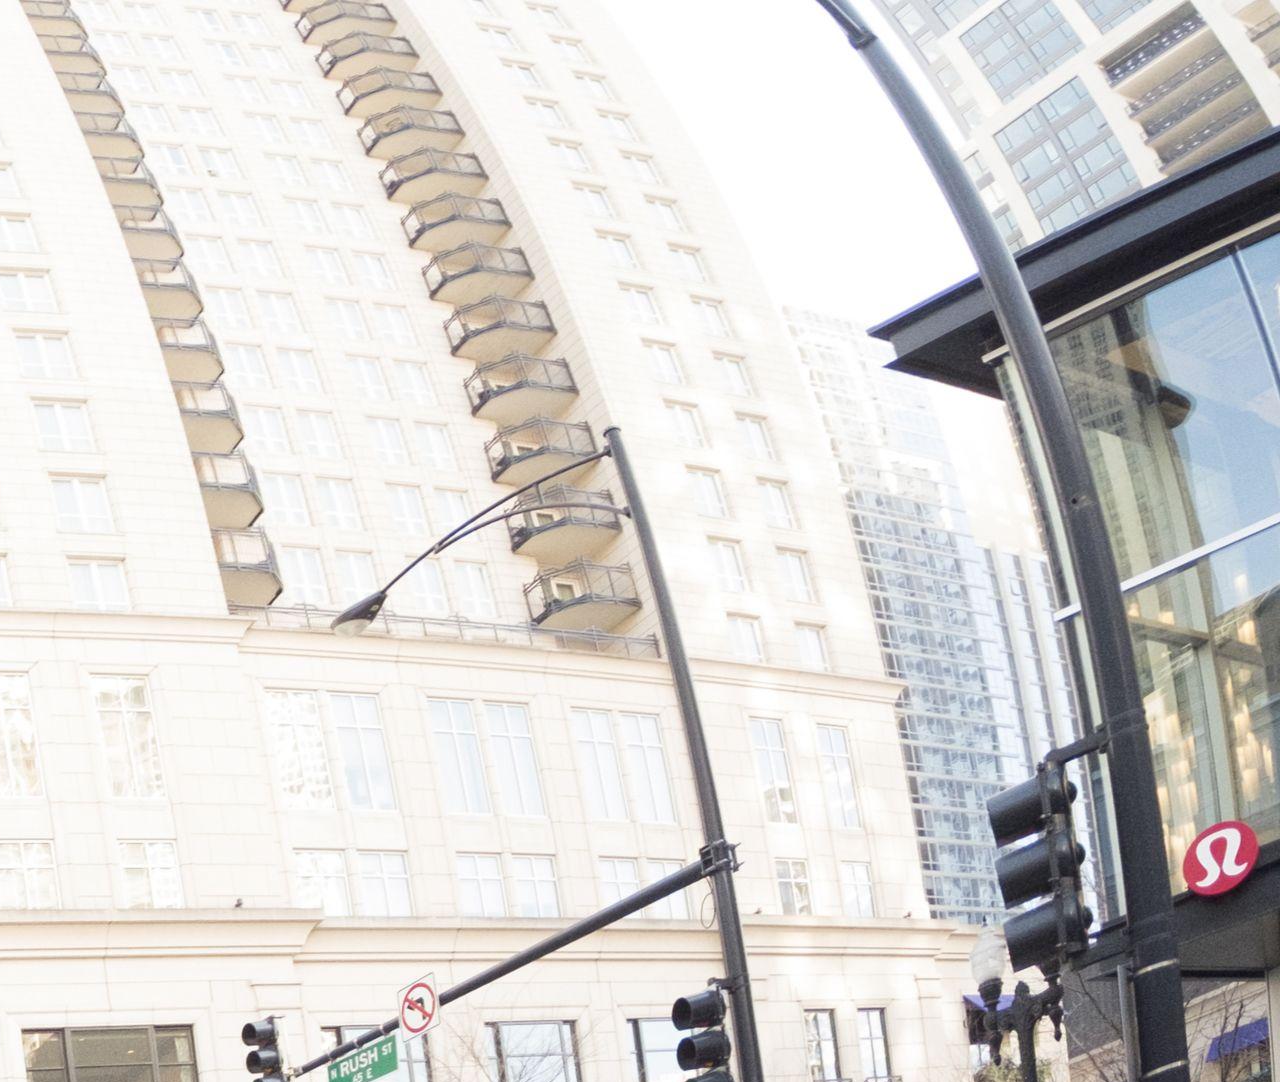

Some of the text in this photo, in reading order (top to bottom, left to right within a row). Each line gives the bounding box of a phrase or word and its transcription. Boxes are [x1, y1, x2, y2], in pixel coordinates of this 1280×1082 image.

[330, 1041, 393, 1080] N RUSH ST
[366, 1067, 374, 1080] E
